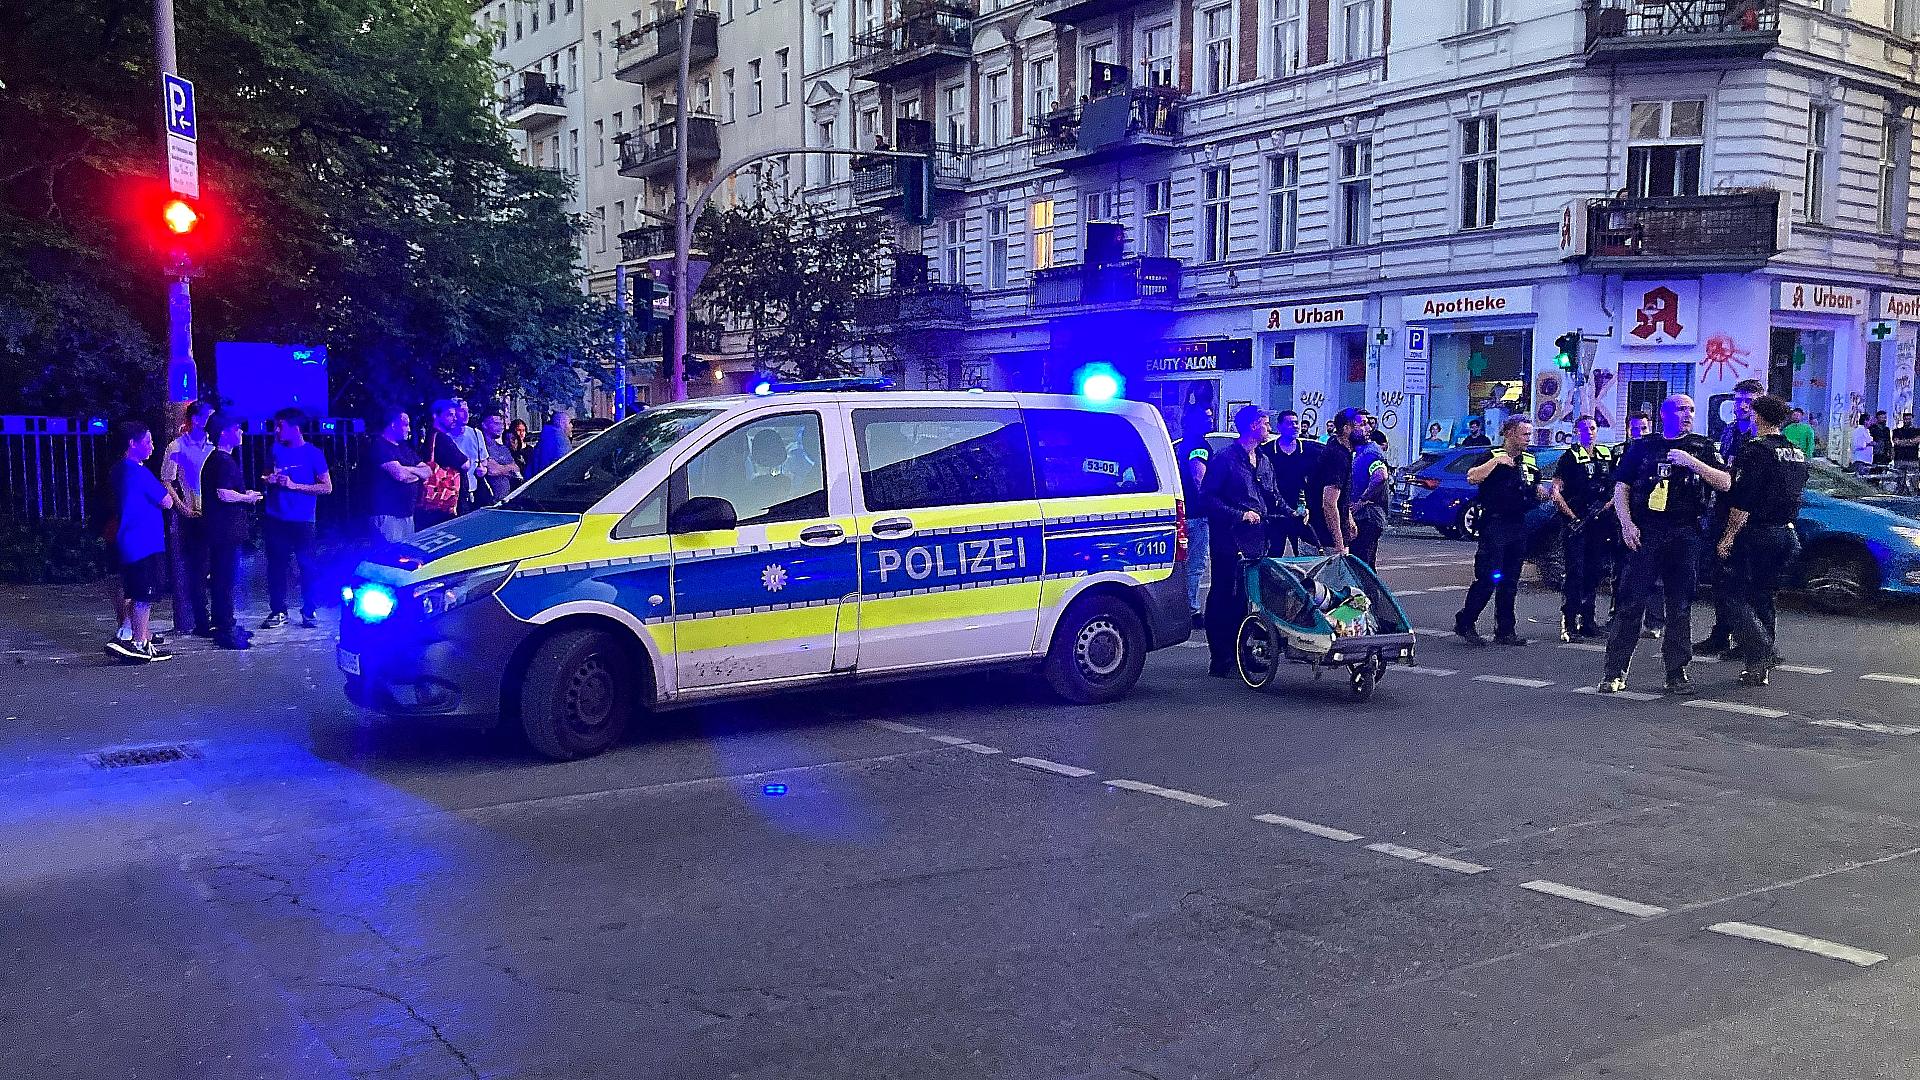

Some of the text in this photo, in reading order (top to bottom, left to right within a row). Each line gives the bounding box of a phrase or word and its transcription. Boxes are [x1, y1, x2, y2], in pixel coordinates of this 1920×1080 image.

[169, 82, 186, 127] P
[1423, 295, 1506, 318] Apotheke
[1294, 307, 1344, 324] Urban
[1412, 332, 1421, 348] P
[1145, 357, 1181, 371] EAUTY
[1146, 541, 1167, 555] 110
[878, 536, 1026, 583] POLIZEI
